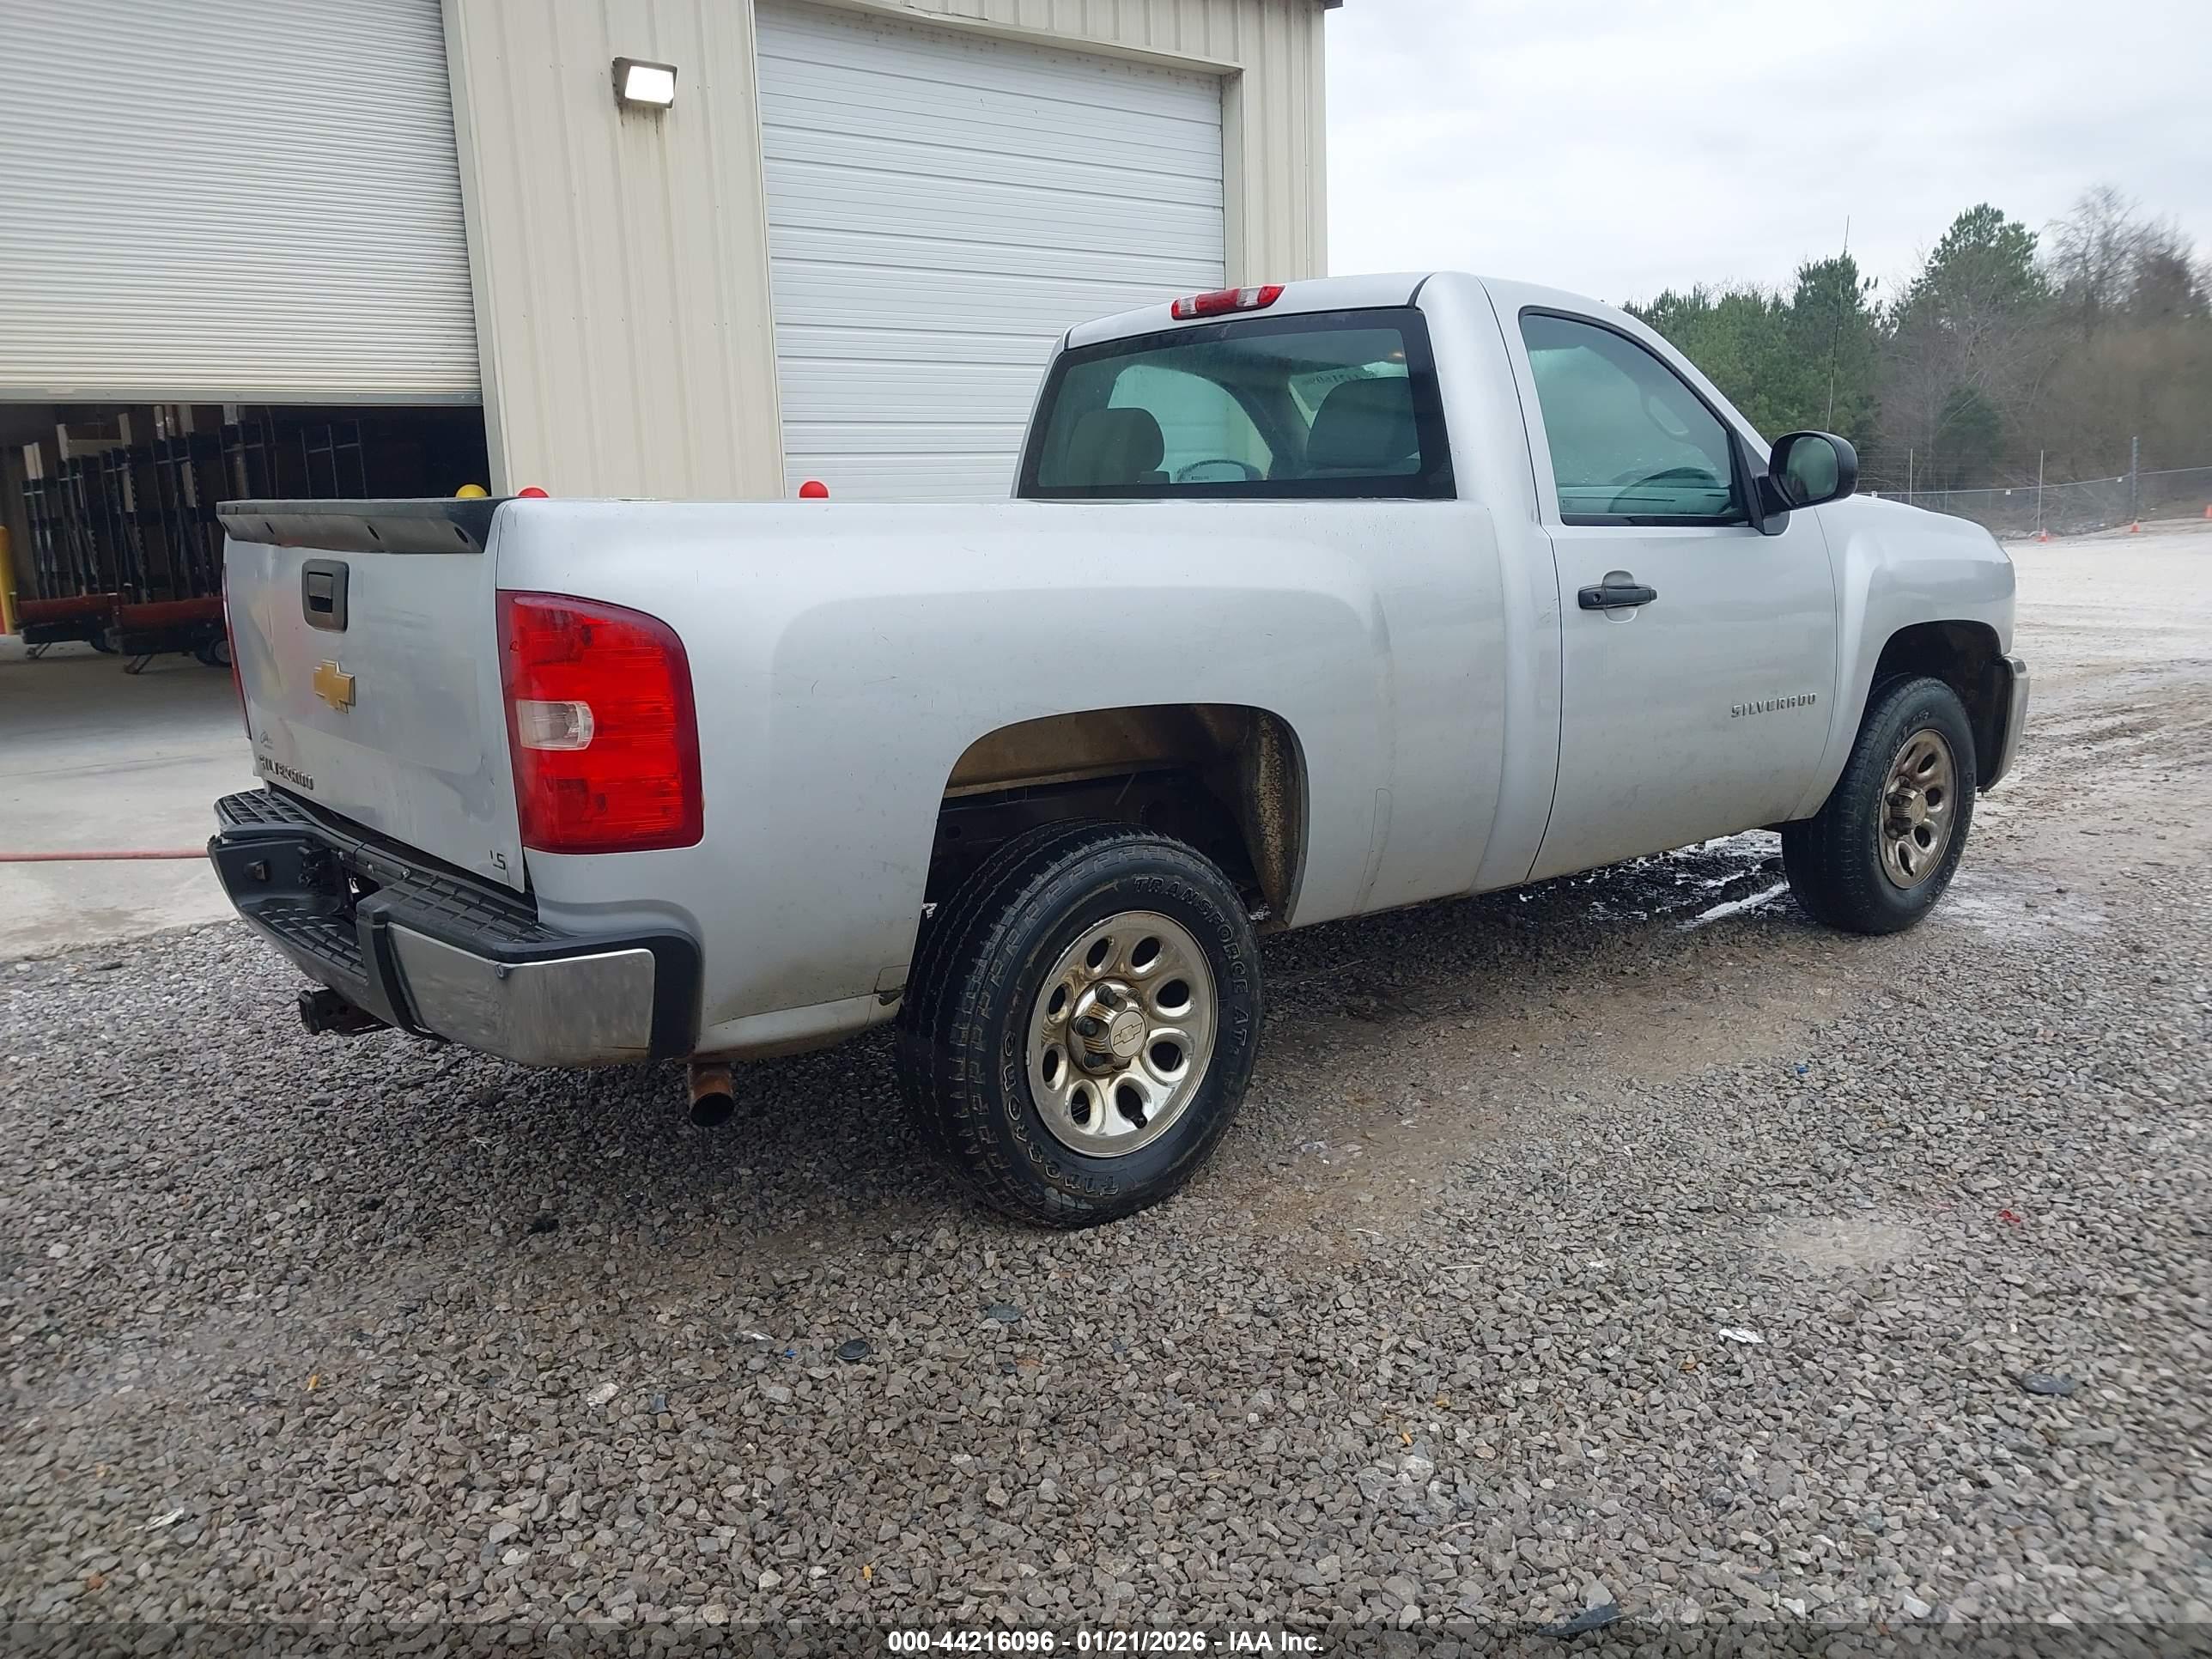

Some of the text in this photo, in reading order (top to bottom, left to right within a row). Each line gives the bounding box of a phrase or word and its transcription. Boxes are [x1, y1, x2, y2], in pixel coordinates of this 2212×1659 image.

[1731, 693, 1817, 718] SILVERADO
[489, 850, 506, 870] LS
[1134, 878, 1249, 994] TRANSFORCE
